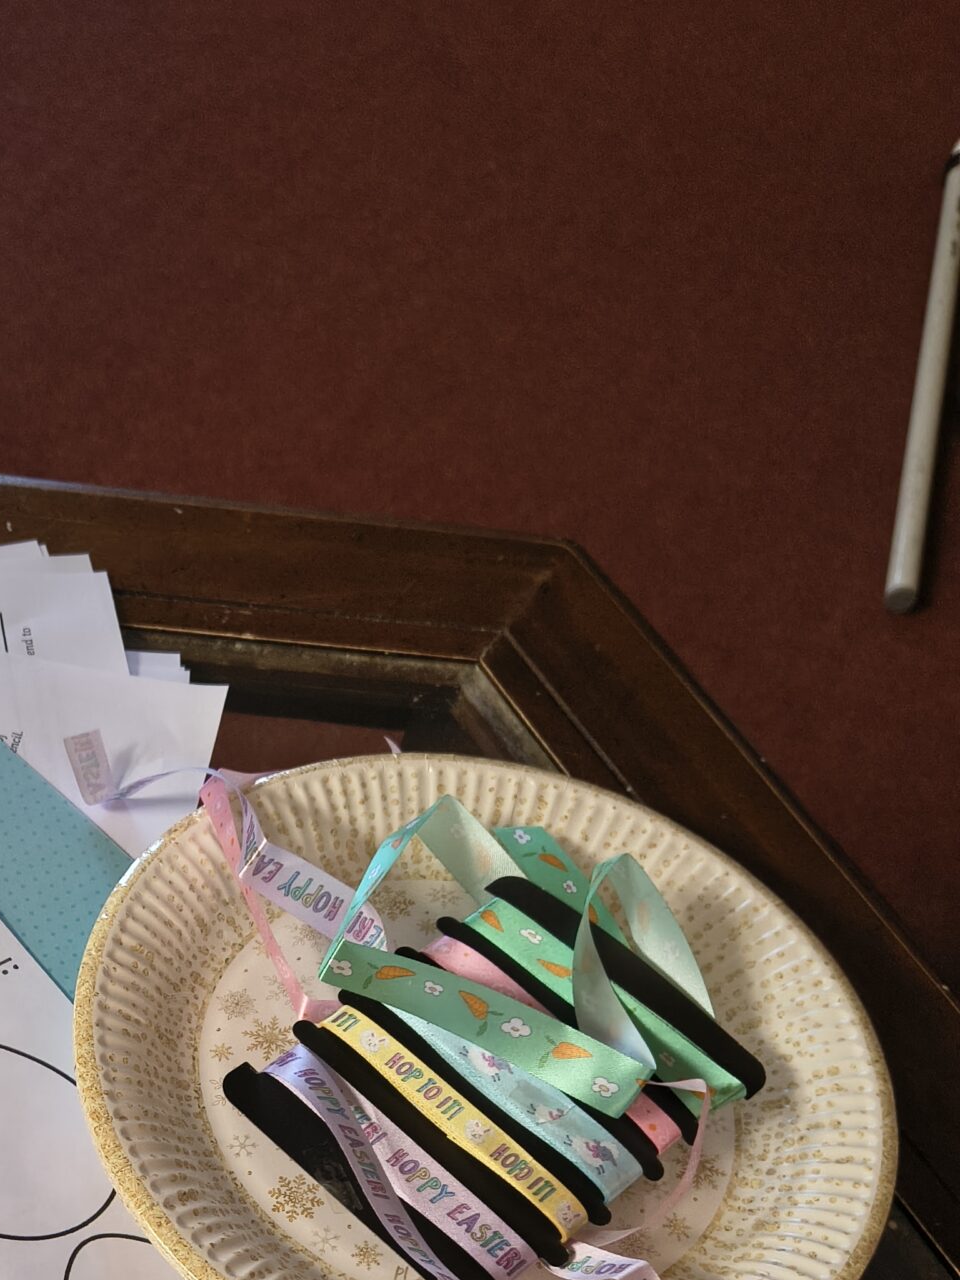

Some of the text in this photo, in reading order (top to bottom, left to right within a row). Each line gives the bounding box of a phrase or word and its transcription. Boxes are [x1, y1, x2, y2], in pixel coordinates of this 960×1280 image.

[277, 871, 344, 922] HOPPY
[293, 1067, 350, 1121] HOPPY
[384, 1052, 424, 1083] HOP
[416, 1077, 443, 1101] TO
[385, 1148, 456, 1204] HOPPY
